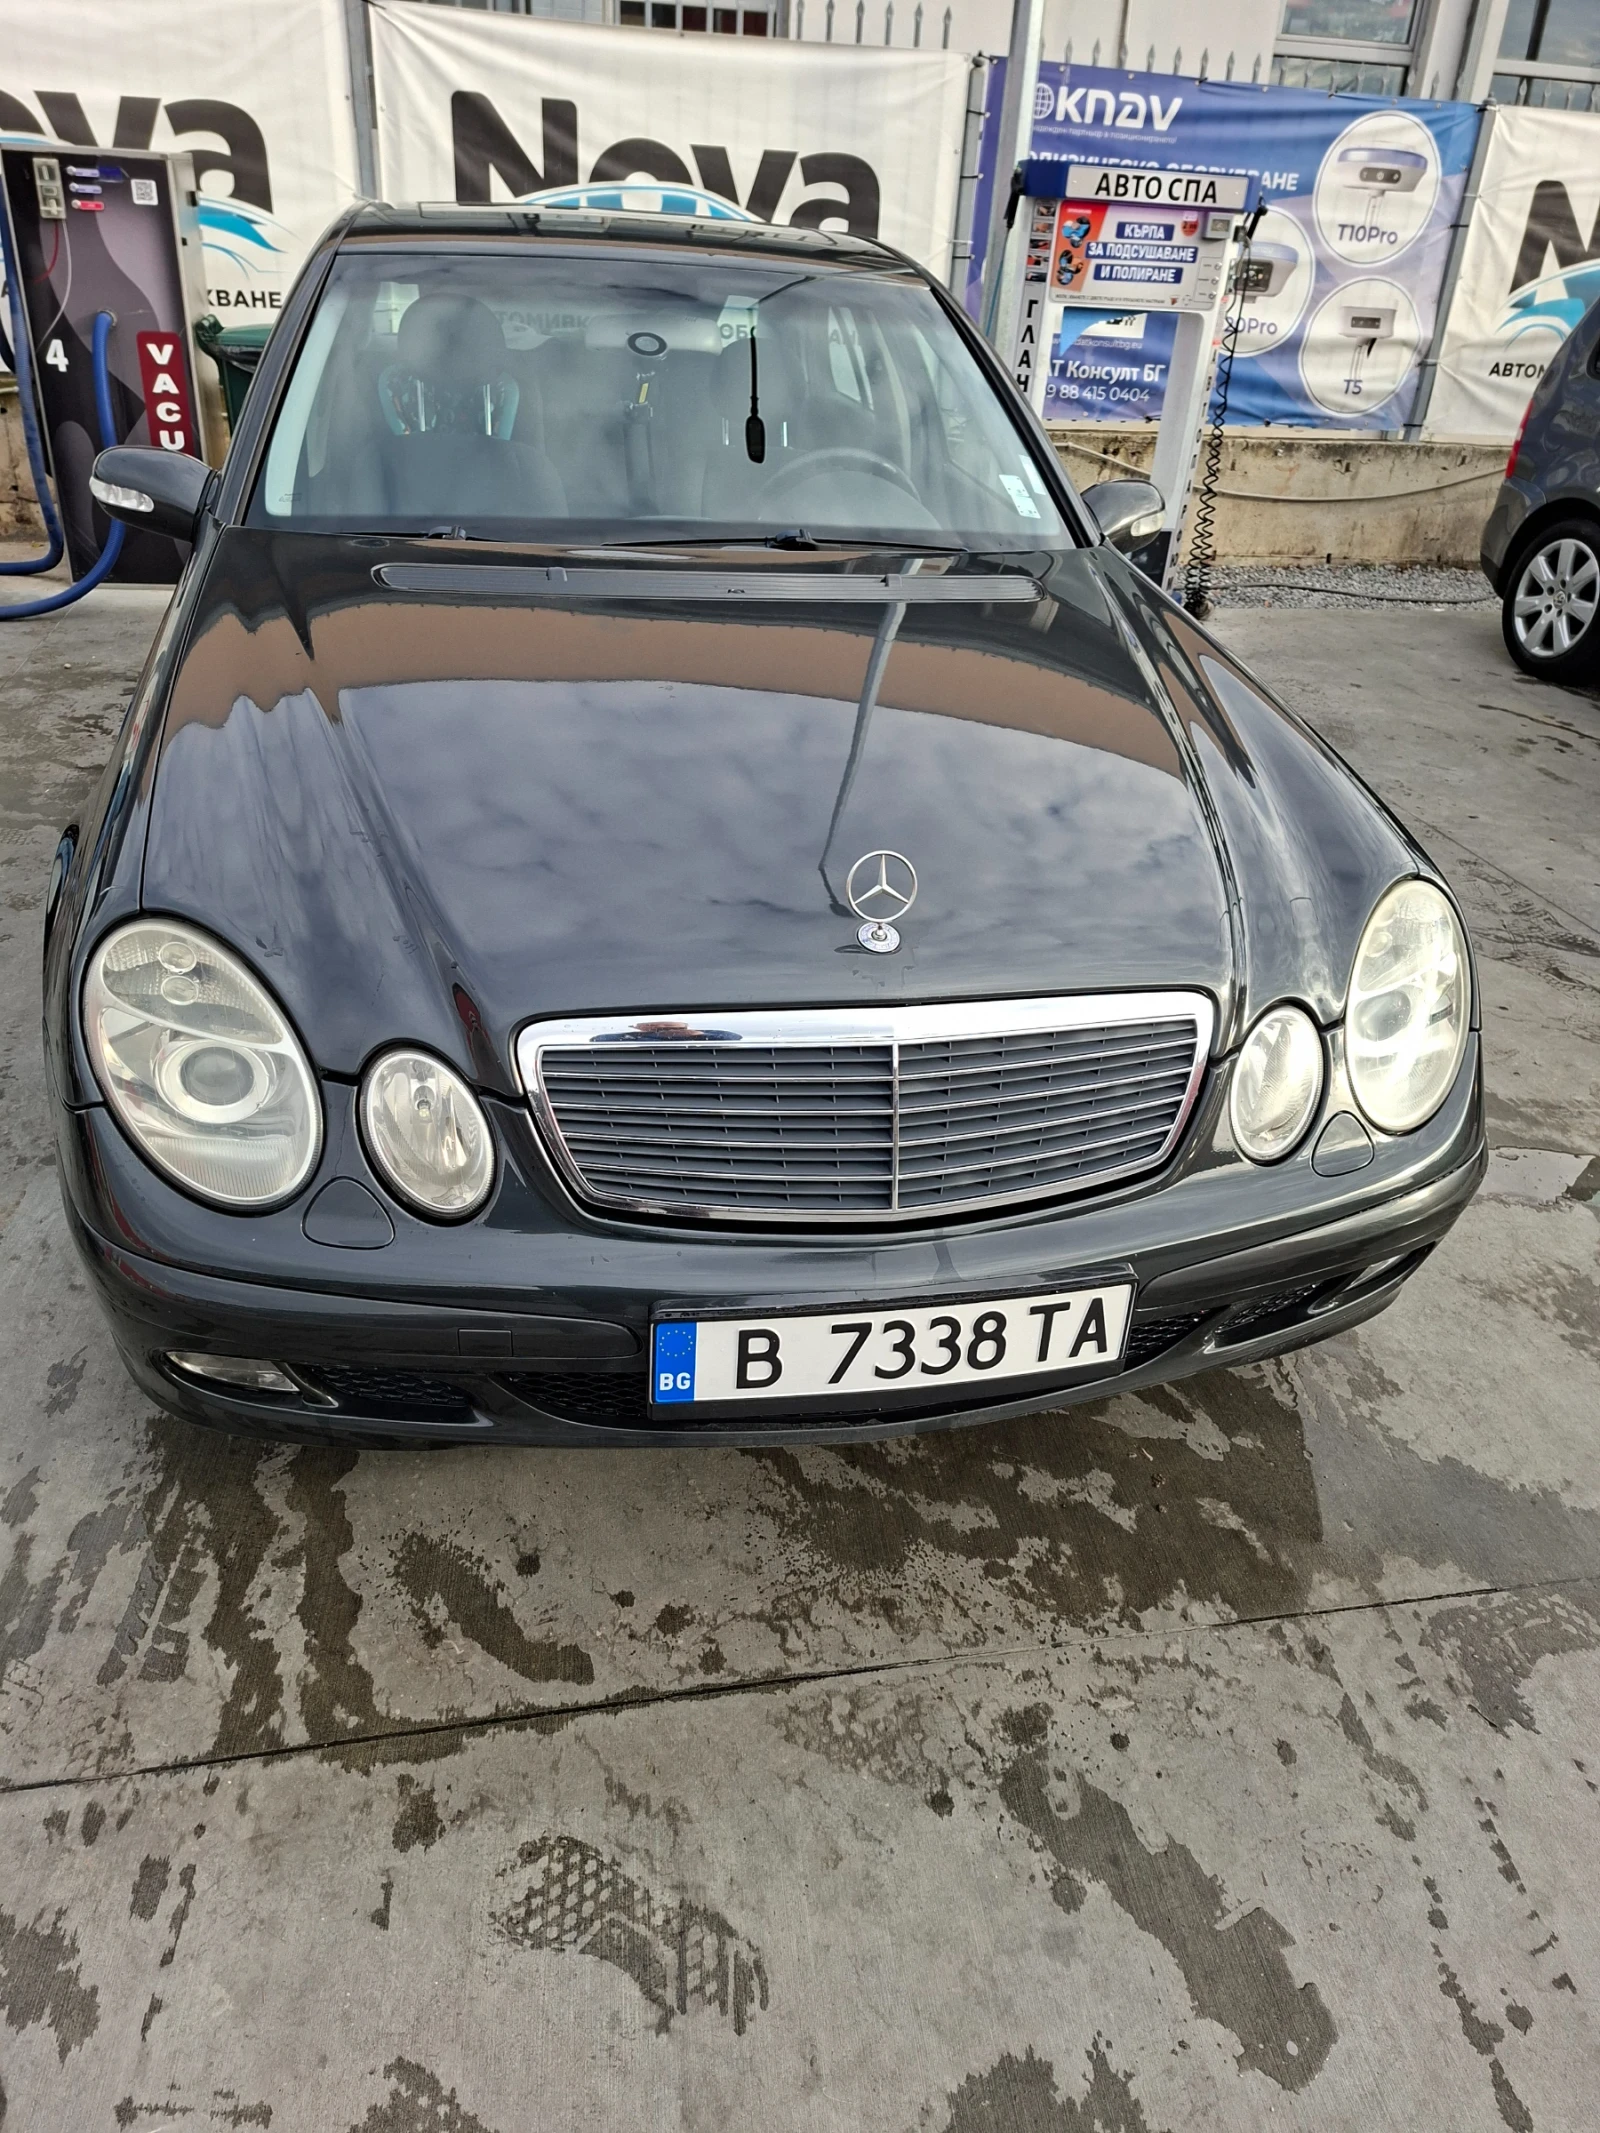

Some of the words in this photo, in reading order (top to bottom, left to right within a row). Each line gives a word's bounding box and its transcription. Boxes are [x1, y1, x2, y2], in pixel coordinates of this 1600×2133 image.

[1094, 172, 1162, 200] АВТО
[1168, 177, 1217, 204] СПА
[1124, 223, 1165, 240] КЪРПА
[1337, 223, 1398, 245] T10Pro
[1088, 242, 1104, 256] ЗА
[1104, 243, 1194, 262] ПОДСУШАВАНЕ
[1100, 265, 1111, 278] И
[1111, 265, 1176, 282] ПОЛИРАНЕ
[45, 338, 69, 373] 4
[1066, 359, 1140, 386] Консулт
[1143, 363, 1166, 382] БГ
[1059, 384, 1080, 400] 88
[1081, 385, 1107, 401] 415
[1109, 386, 1150, 403] 0404
[1343, 379, 1362, 396] T5
[736, 1328, 783, 1390] B
[827, 1310, 1007, 1385] 7338
[1029, 1297, 1108, 1362] TA
[659, 1372, 691, 1391] BG
